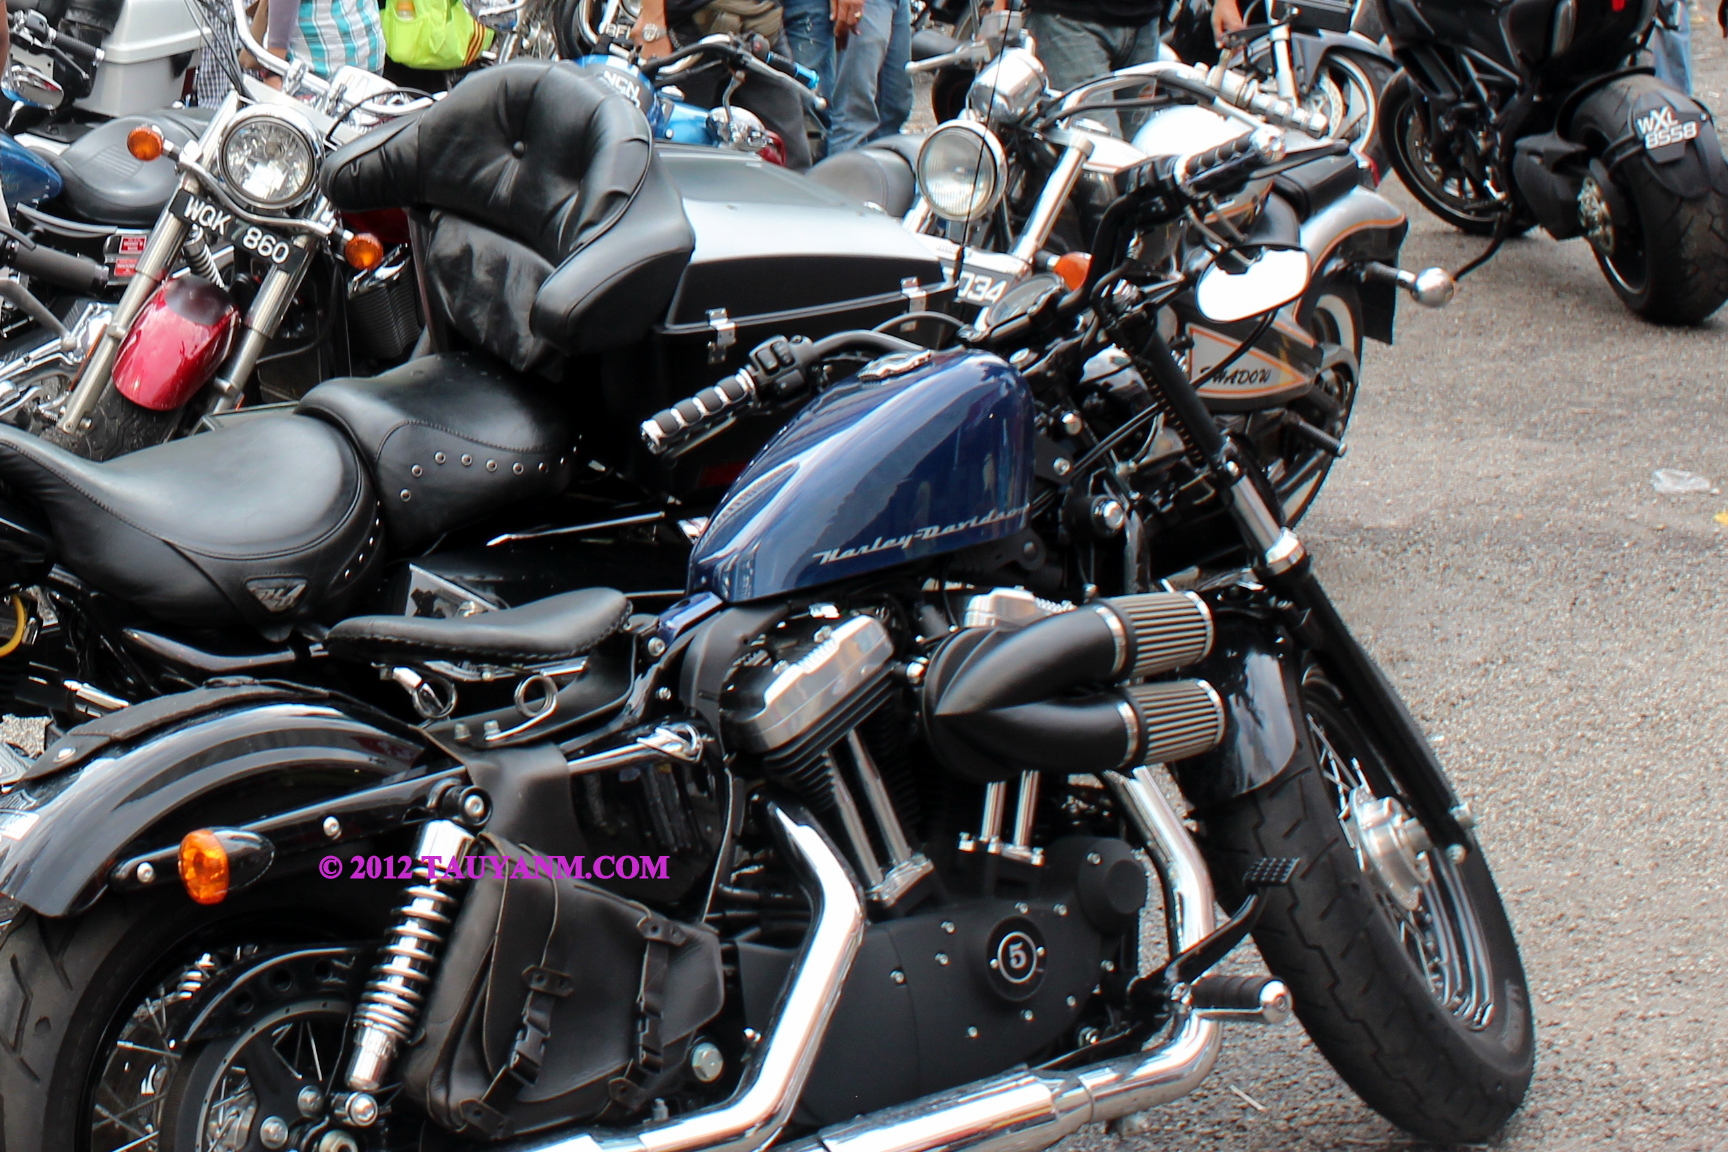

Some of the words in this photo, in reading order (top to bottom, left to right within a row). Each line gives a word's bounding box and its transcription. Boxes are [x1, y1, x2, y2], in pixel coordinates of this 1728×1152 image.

[1636, 106, 1678, 135] WXL
[1644, 121, 1698, 149] 8558
[184, 195, 232, 236] WQK
[1008, 941, 1028, 969] 5
